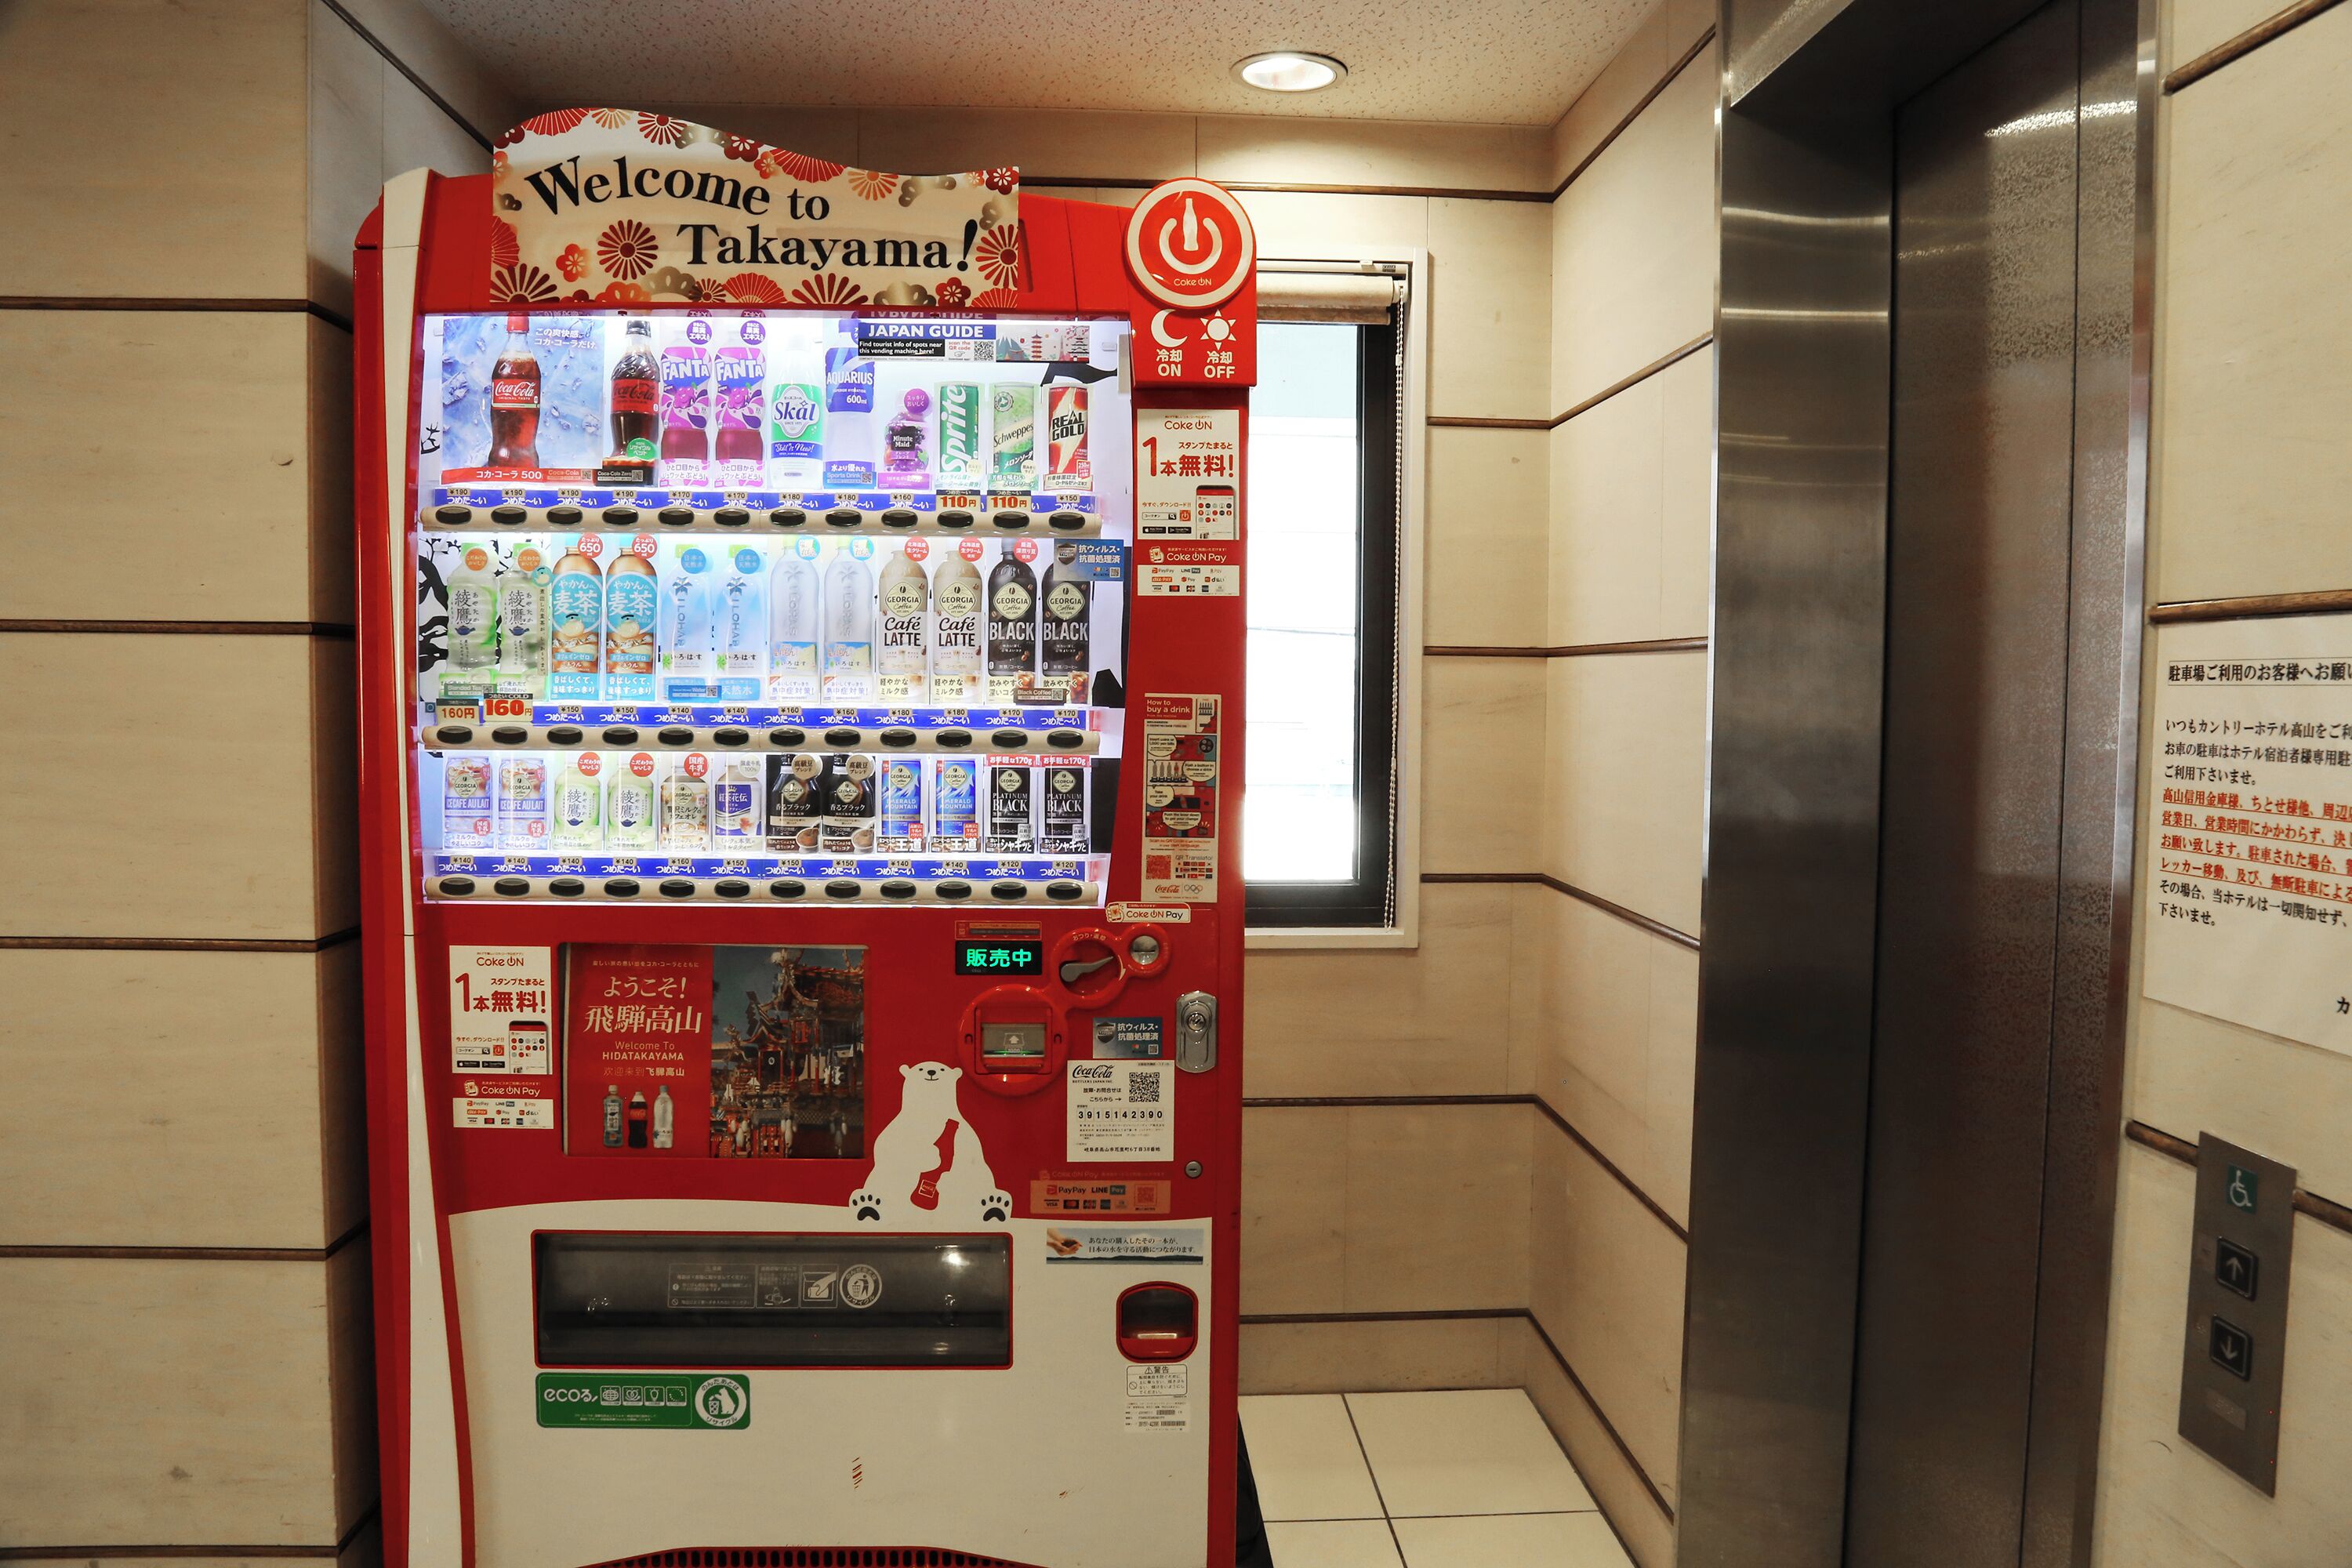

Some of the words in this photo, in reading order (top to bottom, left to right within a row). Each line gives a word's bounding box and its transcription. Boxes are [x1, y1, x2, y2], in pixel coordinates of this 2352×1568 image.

[524, 154, 771, 216] Welcome
[789, 187, 829, 221] to
[677, 219, 978, 271] Takayama!
[1198, 278, 1211, 286] ON
[869, 325, 924, 337] JAPAN
[929, 325, 983, 338] GUIDE
[1156, 349, 1182, 362] 冷却
[1207, 351, 1232, 365] 冷却
[662, 359, 710, 381] FANTA
[716, 360, 764, 381] FANTA
[1157, 364, 1181, 377] ON
[1204, 365, 1236, 379] OFF
[826, 372, 873, 385] AQUARIUS
[495, 381, 535, 397] Coca-Cola
[847, 395, 867, 404] 600ml
[1053, 410, 1084, 430] REAL
[1164, 420, 1193, 430] Coke
[1195, 419, 1212, 430] ON
[941, 386, 972, 474] Sprite
[994, 423, 1033, 447] Schweppes
[1053, 423, 1084, 441] GOLD
[1178, 441, 1233, 450] スタンプたまると
[1142, 437, 1234, 477] 1本無料!
[476, 470, 518, 479] コカ・コーラ
[521, 471, 542, 480] 500
[940, 496, 977, 507] 110円
[991, 496, 1027, 508] 110円
[579, 543, 601, 553] 650
[633, 543, 655, 554] 650
[1079, 555, 1120, 564] 抗菌処理済
[1192, 552, 1206, 561] ON
[1208, 554, 1227, 563] Pay
[454, 590, 471, 625] 綾鷹
[509, 590, 526, 625] 綾鷹
[554, 590, 600, 615] 麦茶
[608, 591, 655, 616] 麦茶
[884, 616, 921, 632] Café
[939, 617, 975, 633] Café
[989, 622, 1035, 641] BLACK
[1044, 622, 1088, 641] BLACK
[884, 633, 921, 647] LATTE
[939, 633, 975, 647] LATTE
[880, 677, 909, 686] 軽やかな
[441, 708, 475, 719] 160円
[485, 699, 532, 716] 160円
[2166, 720, 2352, 740] いつもカントリーホテル高山をご利
[989, 757, 1033, 765] お手軽な170g
[1044, 757, 1086, 765] お手軽な170g
[689, 764, 704, 772] 牛乳
[2165, 764, 2256, 786] ご利用下さいませ。
[567, 789, 582, 818] 綾鷹
[621, 789, 635, 818] 綾鷹
[718, 793, 747, 802] 紅茶花伝
[993, 800, 1028, 811] BLACK
[1047, 800, 1082, 812] BLACK
[895, 838, 922, 851] 王道
[950, 838, 978, 851] 王道
[1001, 839, 1032, 852] シャキッと
[1056, 839, 1087, 852] シャキッと
[1155, 885, 1180, 894] Coca-Cola
[1166, 911, 1183, 920] Pay
[2159, 902, 2216, 926] 下さいませ。
[476, 957, 505, 967] Coke
[507, 956, 524, 967] ON
[966, 949, 1032, 967] 販売中
[455, 972, 546, 1013] 1本無料!
[604, 976, 687, 999] ようこそ!
[1118, 1032, 1160, 1041] 抗菌処理済
[615, 1041, 659, 1050] Welcome
[663, 1041, 675, 1050] To
[1073, 1065, 1115, 1079] Coca-Cola
[506, 1086, 520, 1094] ON
[522, 1087, 540, 1097] Pay
[1078, 1111, 1163, 1120] 3915142390
[847, 1294, 876, 1305] リサイクル
[706, 1417, 738, 1426] リサイクル
